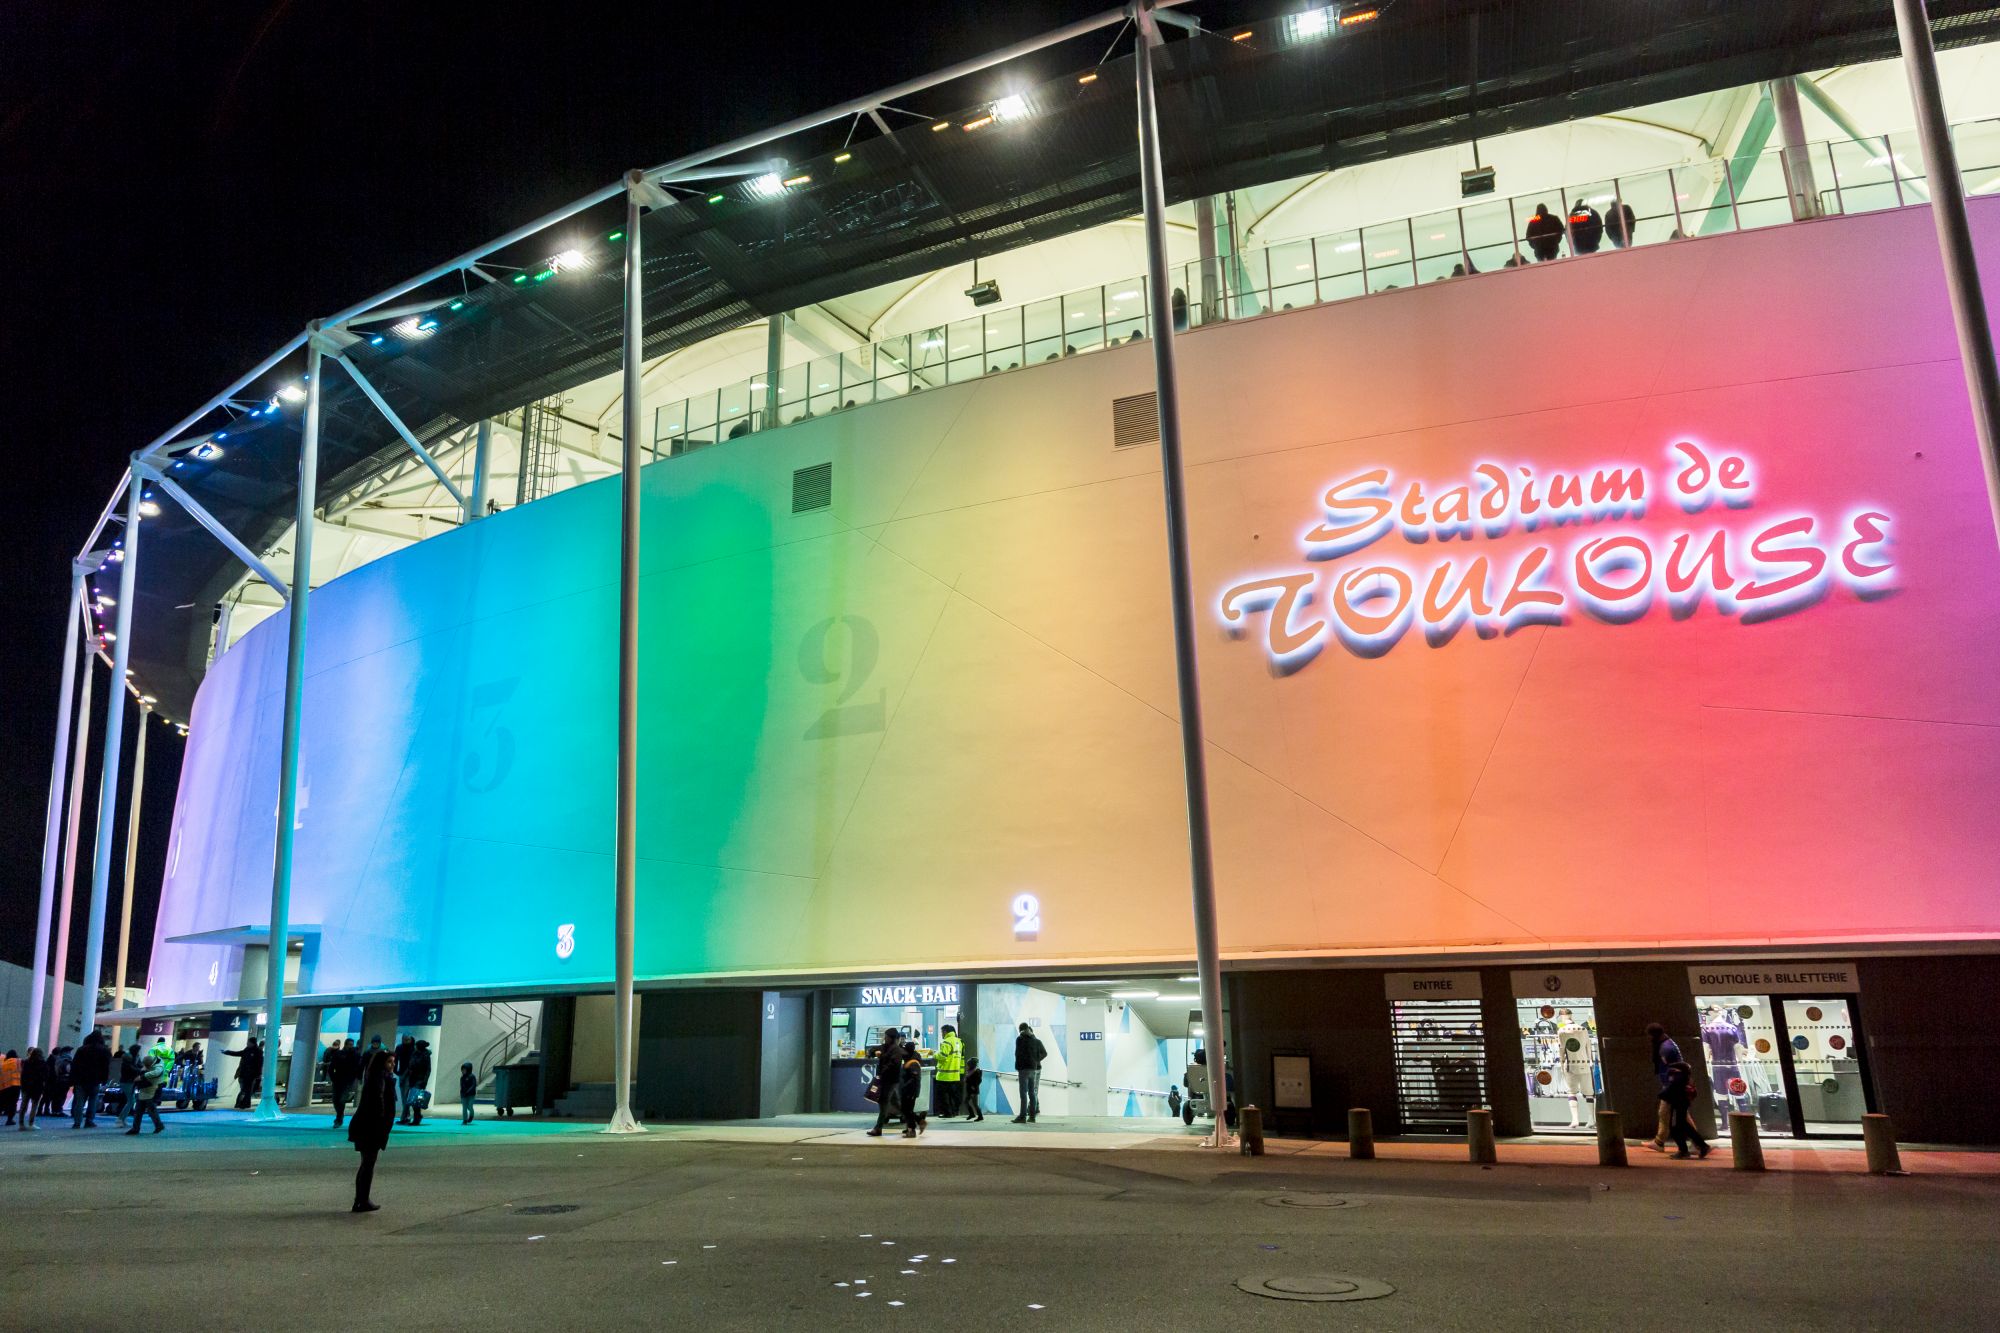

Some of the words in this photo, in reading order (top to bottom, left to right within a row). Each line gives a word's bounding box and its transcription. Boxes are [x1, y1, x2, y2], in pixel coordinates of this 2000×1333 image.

[1303, 462, 1645, 542] Stadium
[1674, 441, 1750, 495] de
[1221, 511, 1896, 655] TOULOUSE
[797, 613, 888, 742] 2
[1013, 893, 1040, 932] 2
[556, 923, 575, 959] 3
[1413, 977, 1453, 990] ENTRÉE
[1699, 974, 1760, 985] BOUTIQUE
[1763, 973, 1772, 984] &
[1776, 972, 1848, 984] BILLETTERIE
[861, 985, 958, 1005] SNACK-BAR
[427, 1008, 437, 1022] 3
[766, 1003, 775, 1020] 2
[154, 1023, 164, 1033] 5
[230, 1016, 241, 1028] 4
